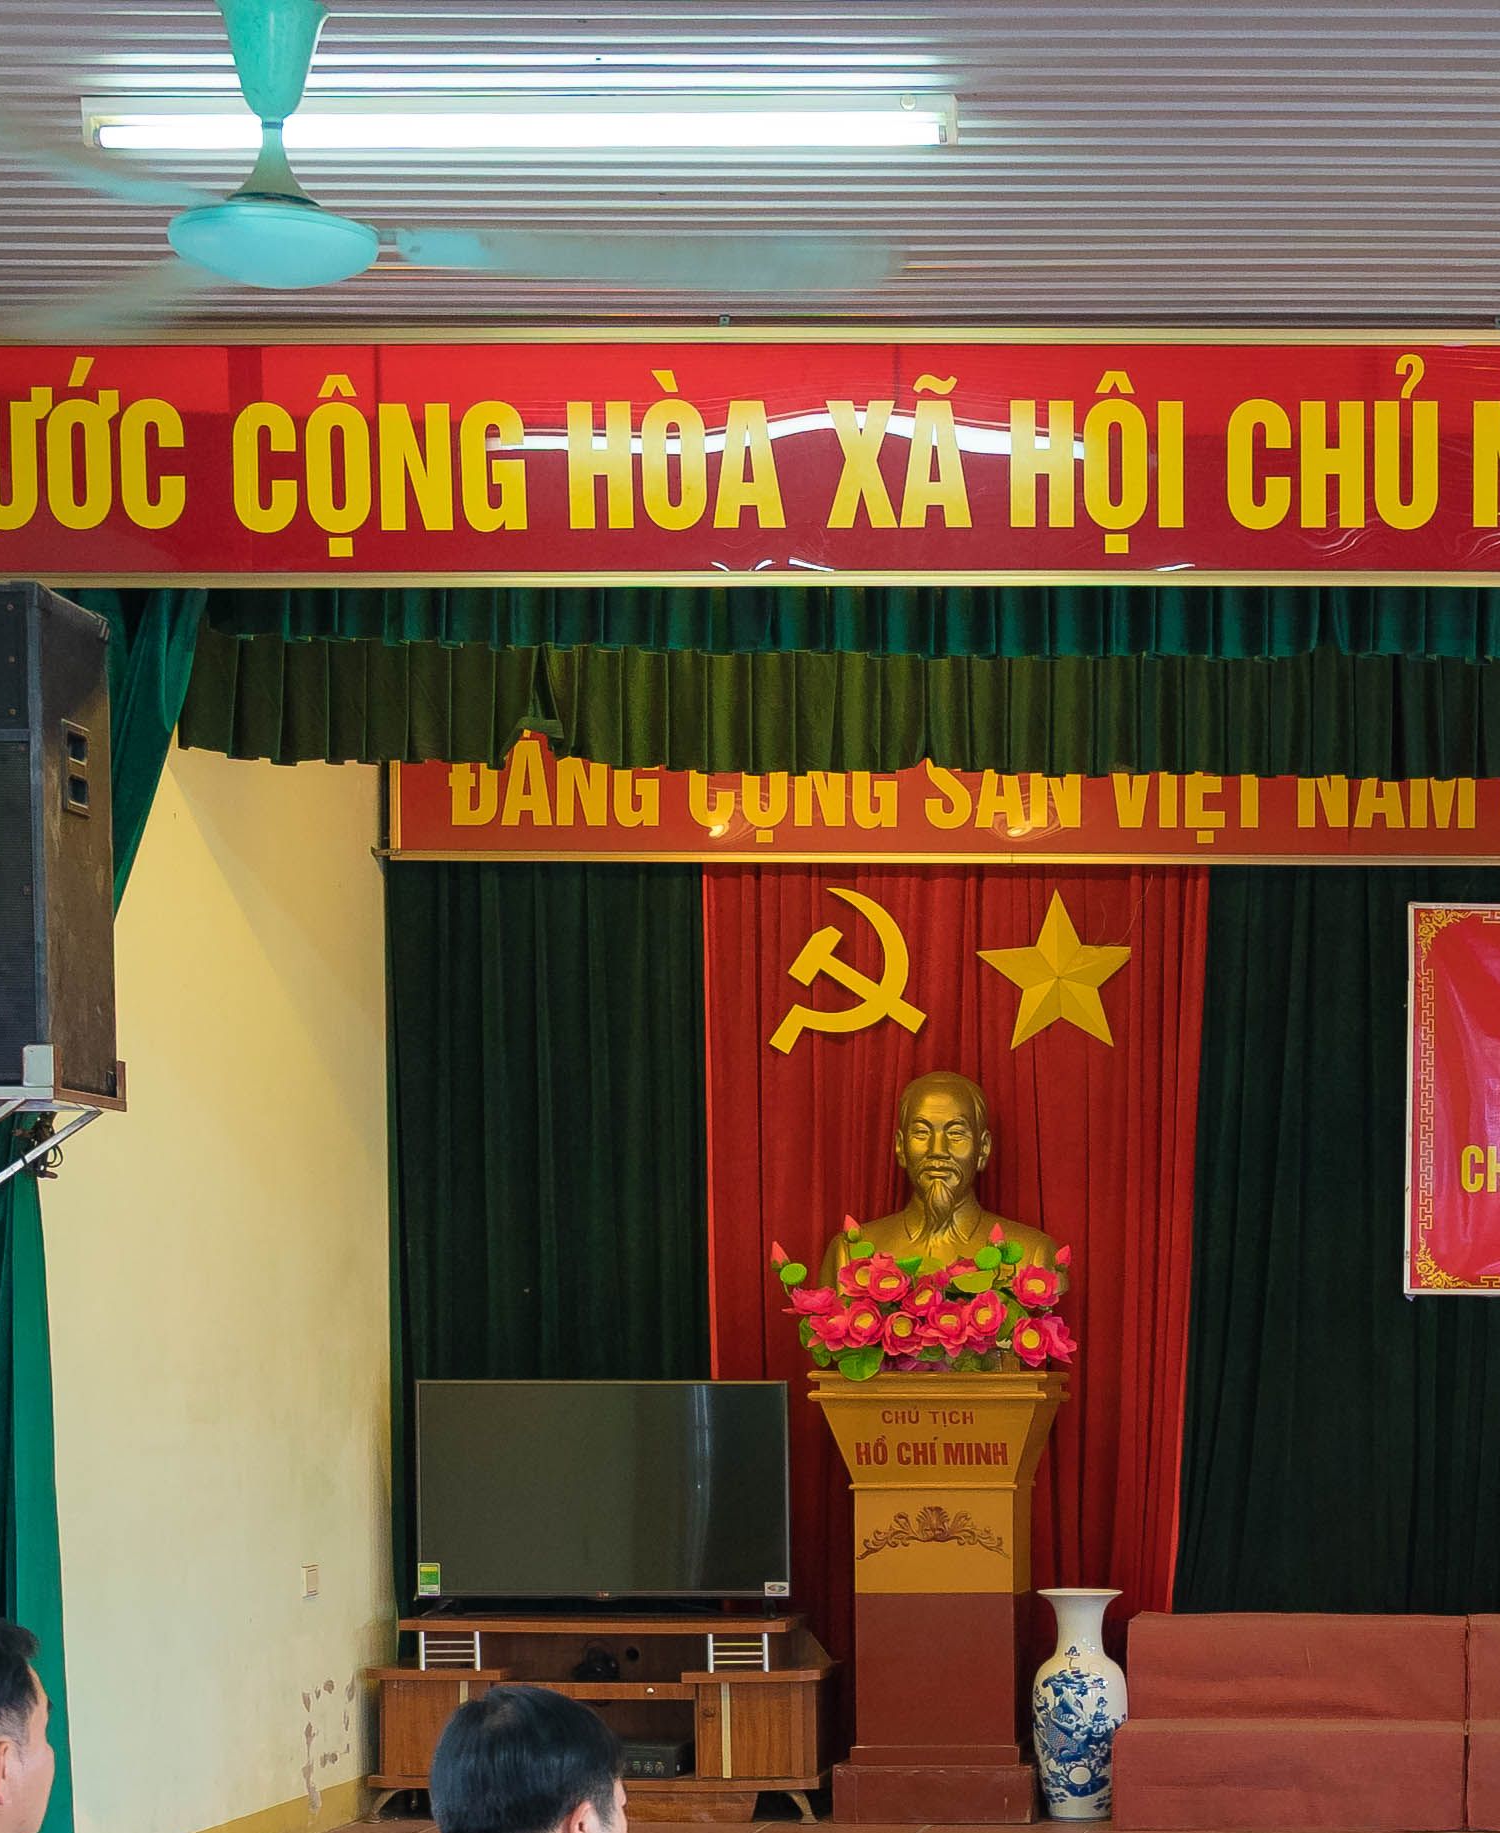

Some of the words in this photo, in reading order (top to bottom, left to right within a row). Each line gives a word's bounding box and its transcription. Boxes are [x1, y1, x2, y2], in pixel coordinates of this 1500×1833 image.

[232, 382, 525, 558] CỘNG
[569, 370, 786, 531] HÒA
[827, 375, 972, 529] XÃ
[1009, 370, 1184, 554] HỘI
[1226, 353, 1440, 530] CHỦ
[881, 1405, 920, 1425] CHỦ
[928, 1410, 975, 1428] TỊCH
[855, 1435, 889, 1466] HỒ
[897, 1436, 938, 1466] CHÍ
[943, 1442, 1009, 1466] MINH
